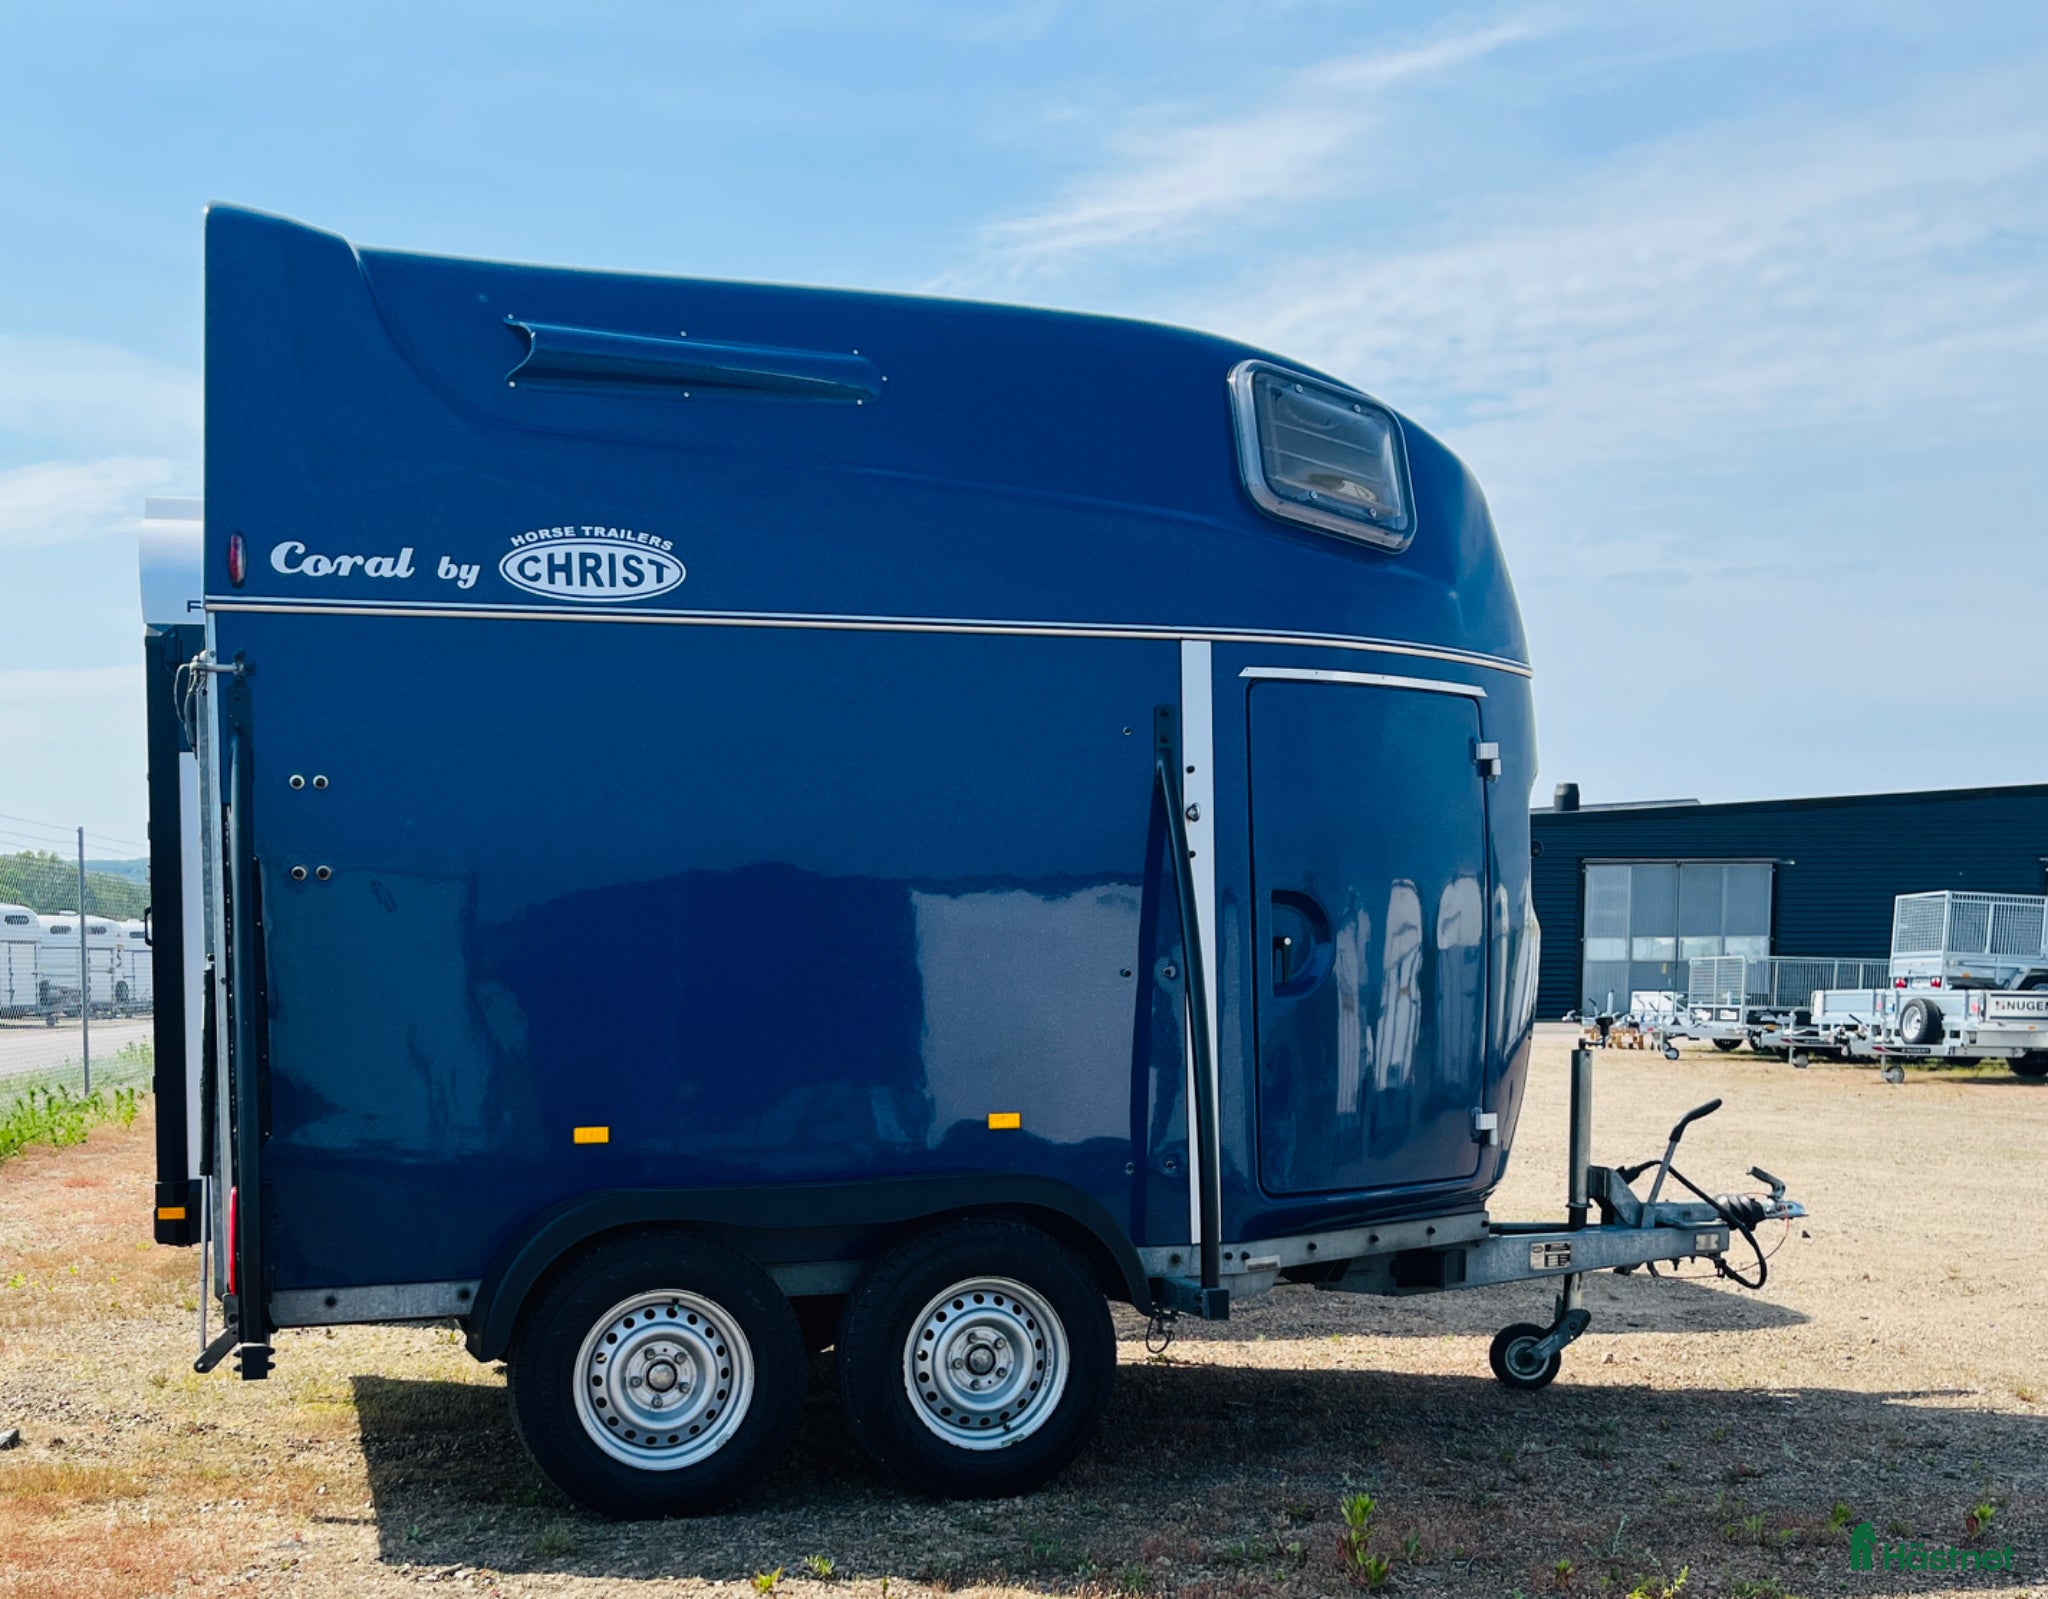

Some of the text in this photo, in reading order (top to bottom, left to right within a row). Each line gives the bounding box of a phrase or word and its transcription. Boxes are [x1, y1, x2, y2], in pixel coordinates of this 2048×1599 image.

[510, 525, 674, 551] HORSE TRAILERS
[270, 540, 672, 590] Coral by CHRIST
